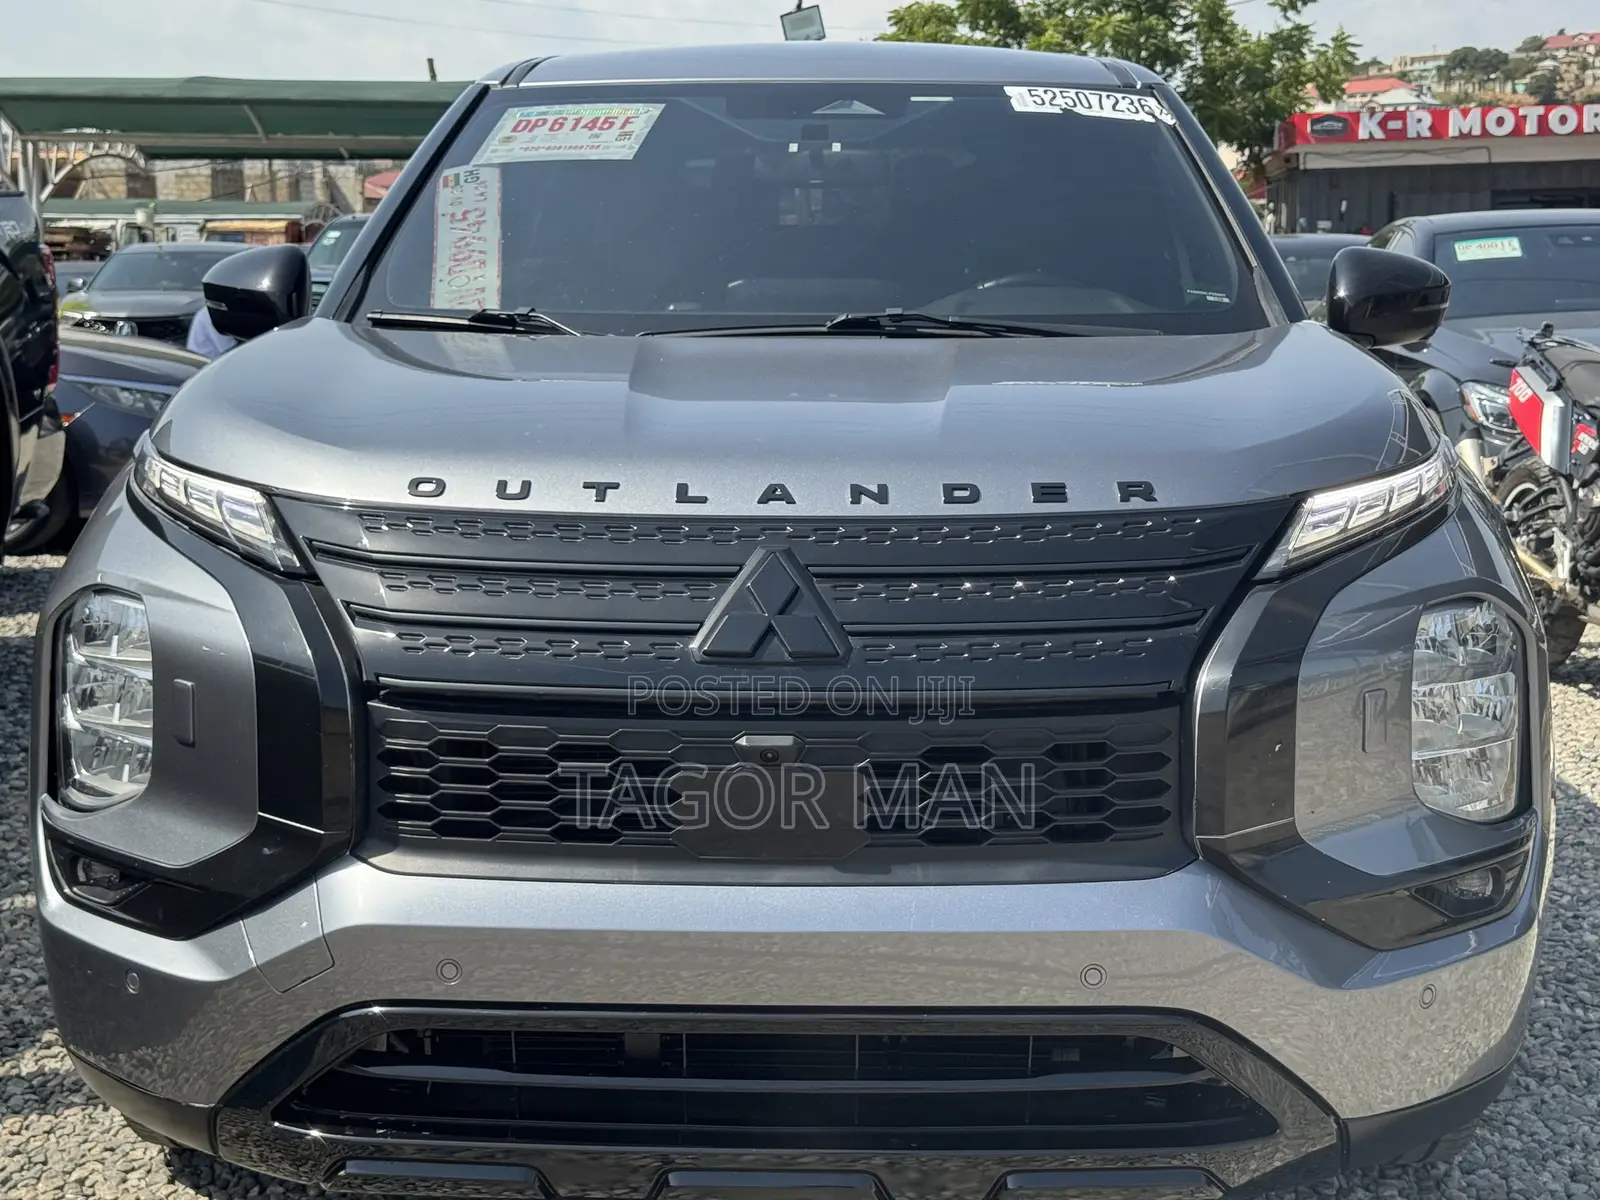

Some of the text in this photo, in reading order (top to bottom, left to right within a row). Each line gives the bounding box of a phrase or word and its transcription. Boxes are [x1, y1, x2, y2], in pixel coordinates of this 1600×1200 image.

[510, 115, 640, 133] DP 6145 F
[1358, 110, 1433, 140] K-R
[463, 168, 481, 184] GH
[407, 476, 1158, 504] OUTLANDER
